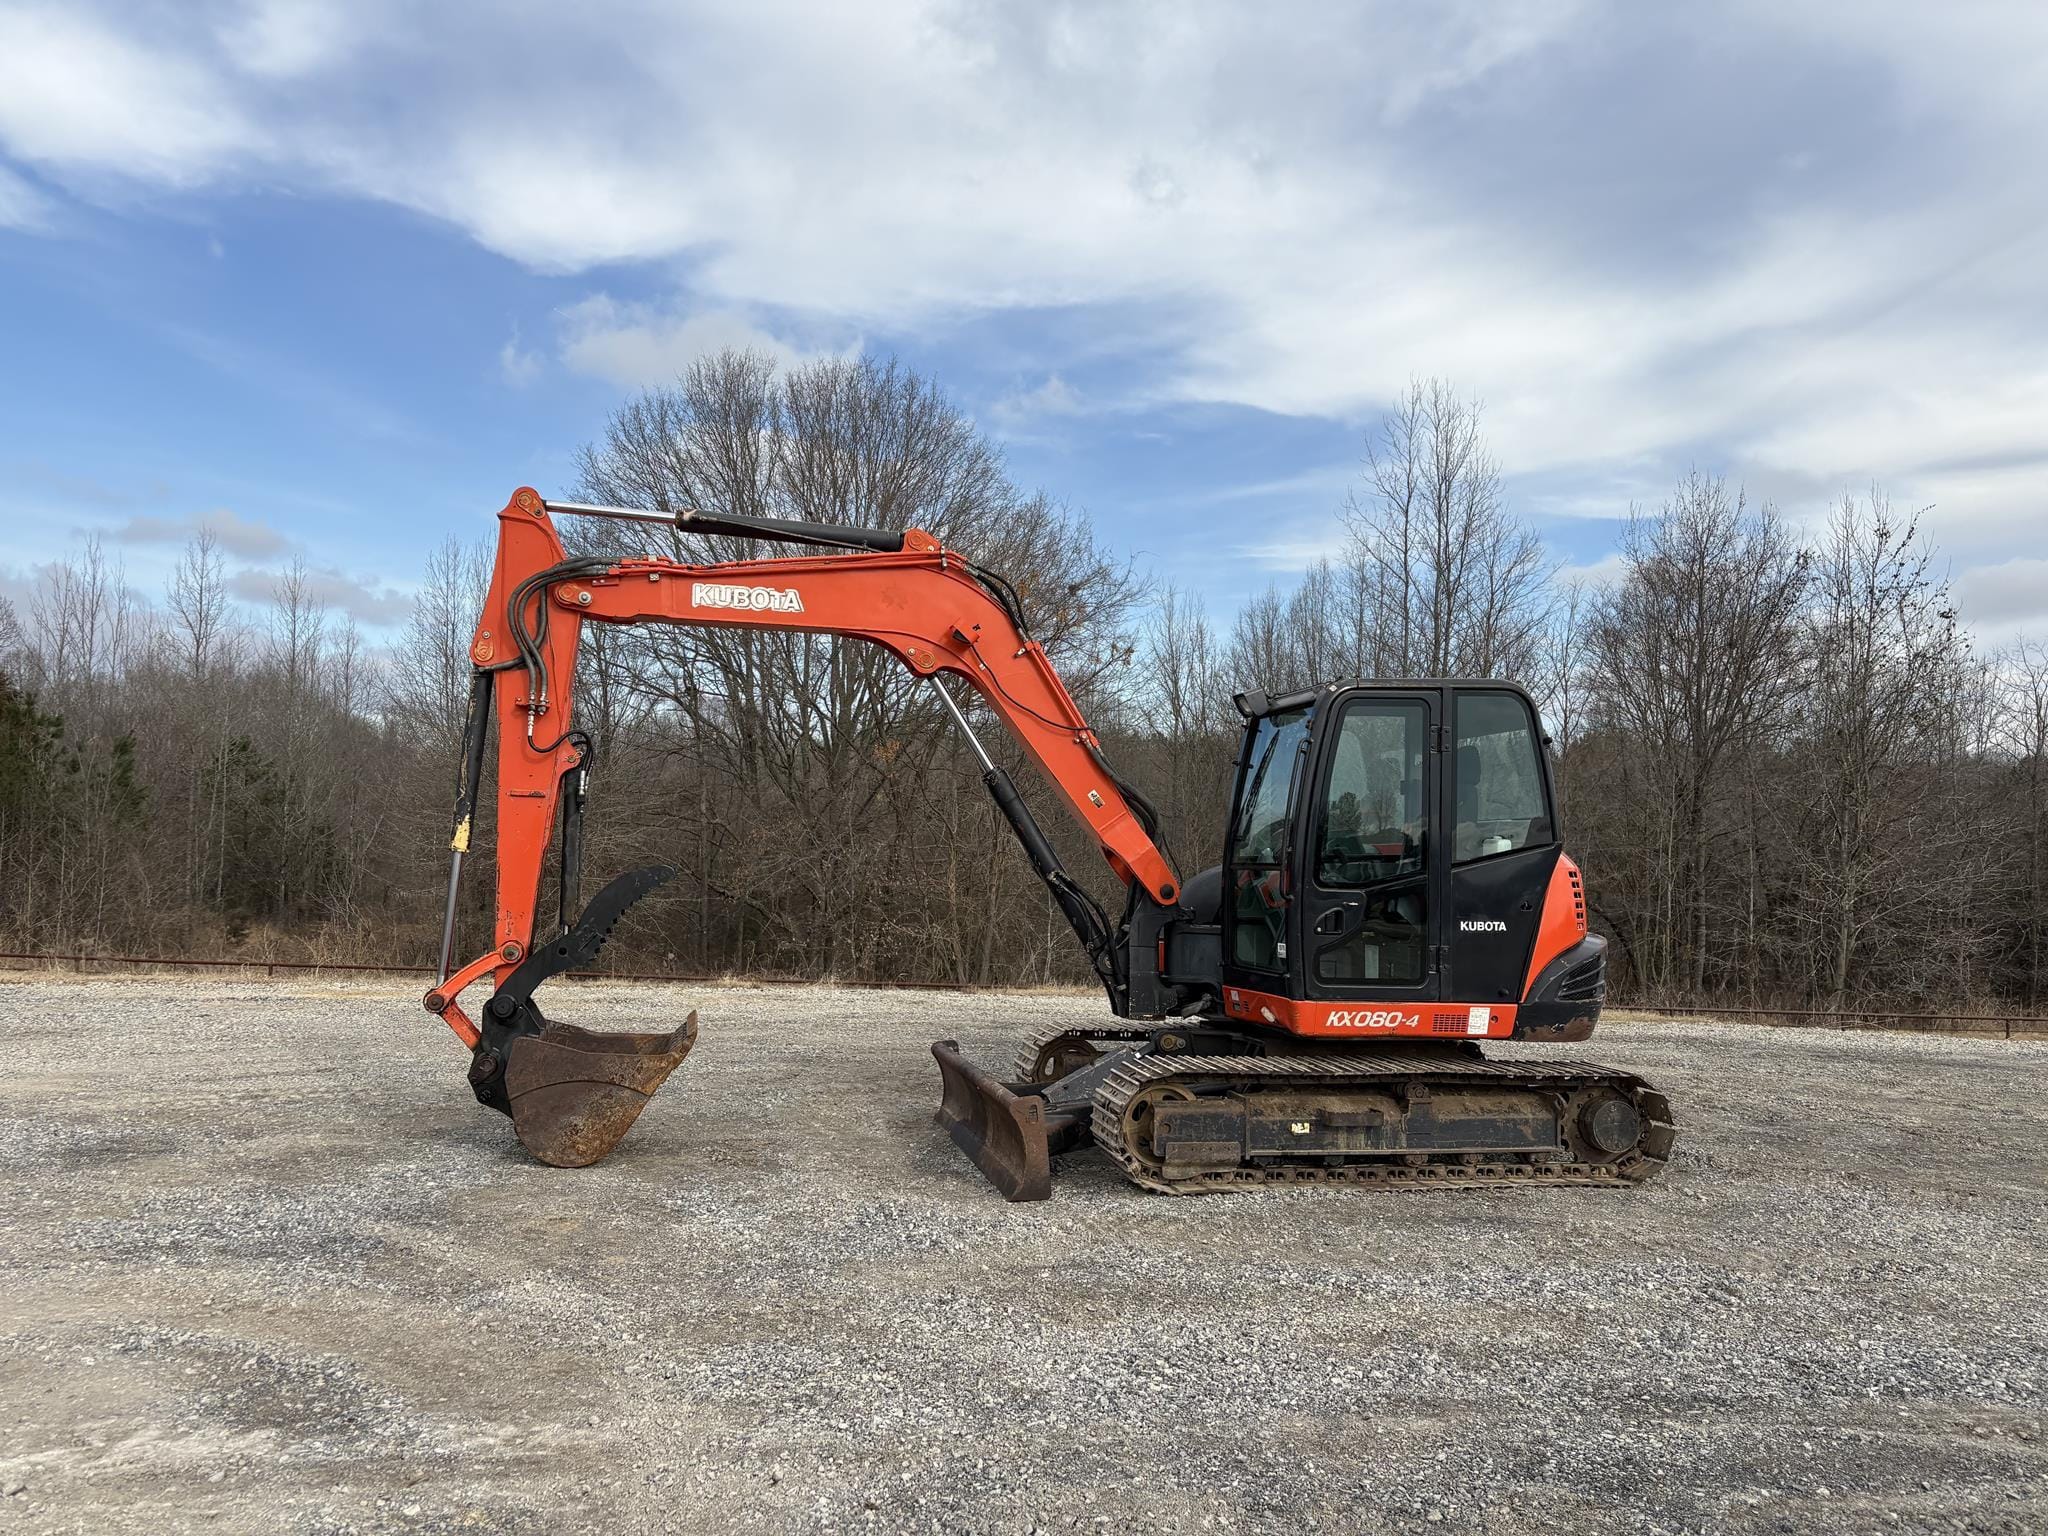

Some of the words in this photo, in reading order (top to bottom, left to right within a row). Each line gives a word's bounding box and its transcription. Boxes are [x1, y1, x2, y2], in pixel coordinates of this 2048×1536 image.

[692, 583, 804, 612] KUBOTA
[1460, 921, 1507, 931] KUBOTA
[1325, 1010, 1419, 1028] KX080-4
